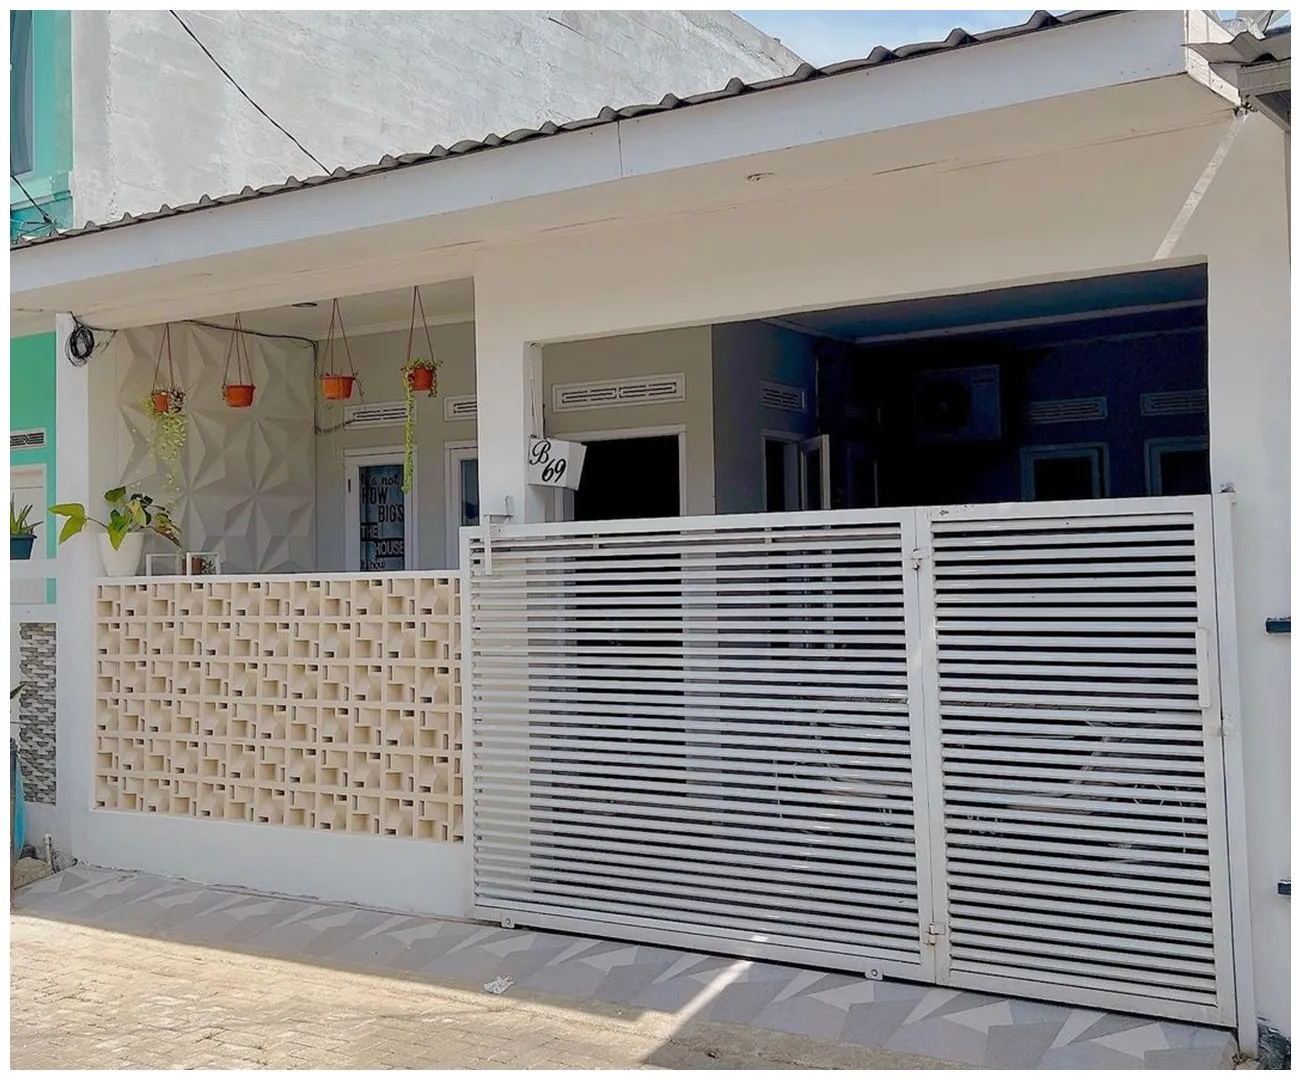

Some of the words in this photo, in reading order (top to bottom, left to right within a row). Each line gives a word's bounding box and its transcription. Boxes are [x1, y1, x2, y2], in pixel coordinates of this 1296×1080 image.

[529, 440, 551, 465] B
[541, 458, 567, 483] 69
[361, 487, 387, 504] HOW
[361, 526, 378, 540] THE
